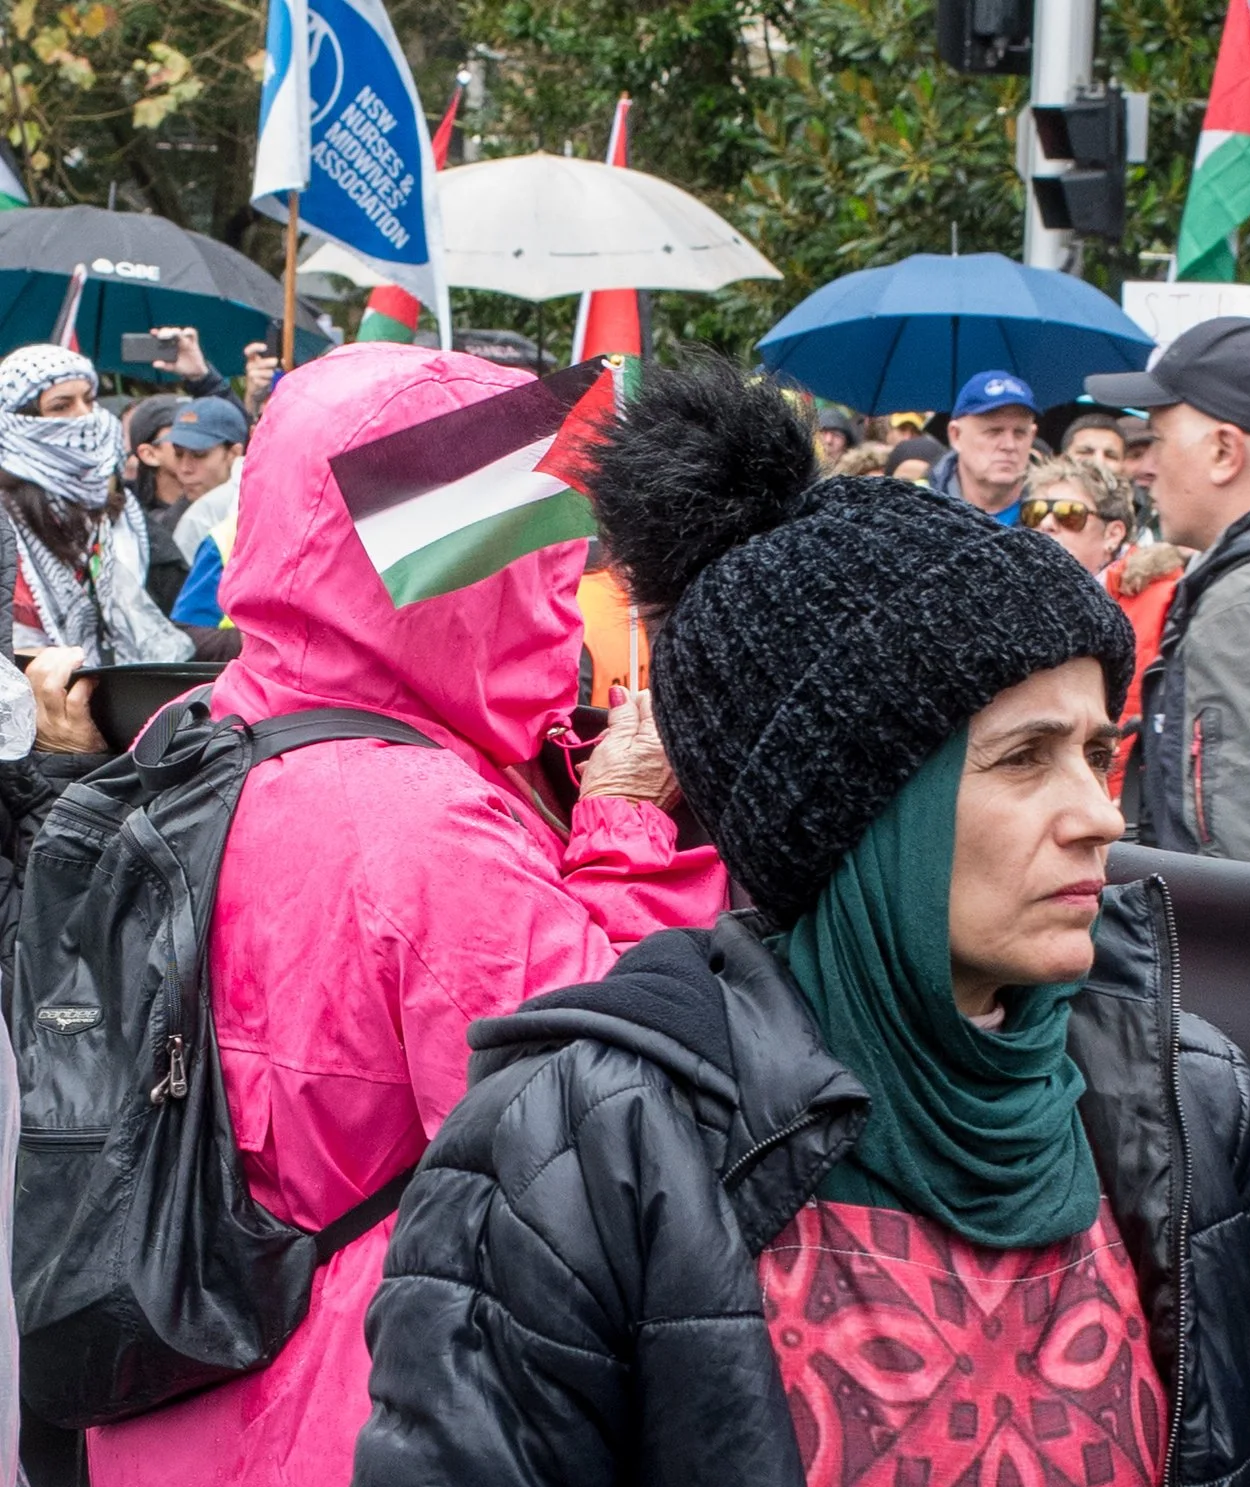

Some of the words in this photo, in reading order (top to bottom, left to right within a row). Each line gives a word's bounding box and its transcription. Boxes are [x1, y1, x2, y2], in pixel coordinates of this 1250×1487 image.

[339, 103, 404, 179] NURSES
[399, 173, 415, 196] &
[355, 85, 398, 134] NSW
[311, 140, 411, 250] ASSOCIATION
[324, 120, 408, 211] MIDWIVES'
